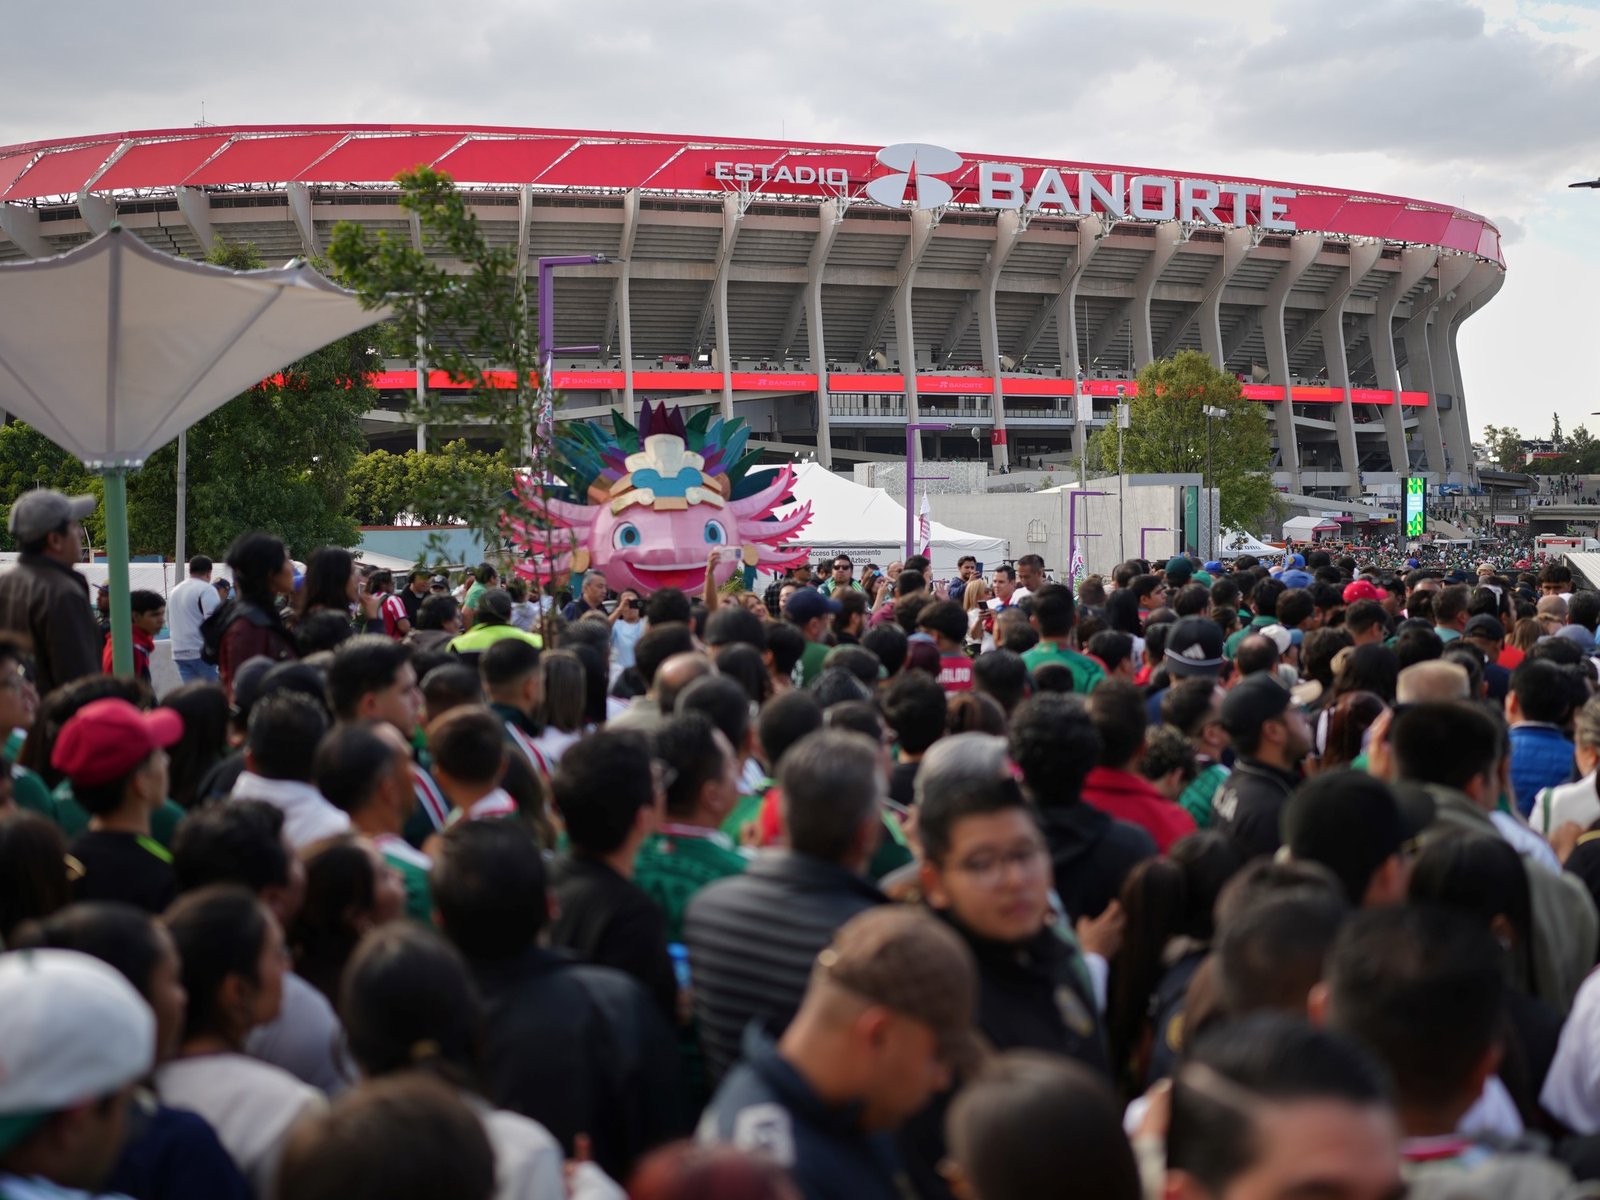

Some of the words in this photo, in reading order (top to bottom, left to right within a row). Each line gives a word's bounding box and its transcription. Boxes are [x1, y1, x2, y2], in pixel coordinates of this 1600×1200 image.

[714, 161, 847, 185] ESTADIO
[979, 163, 1296, 230] BANORTE
[831, 549, 881, 557] Estacionamiento
